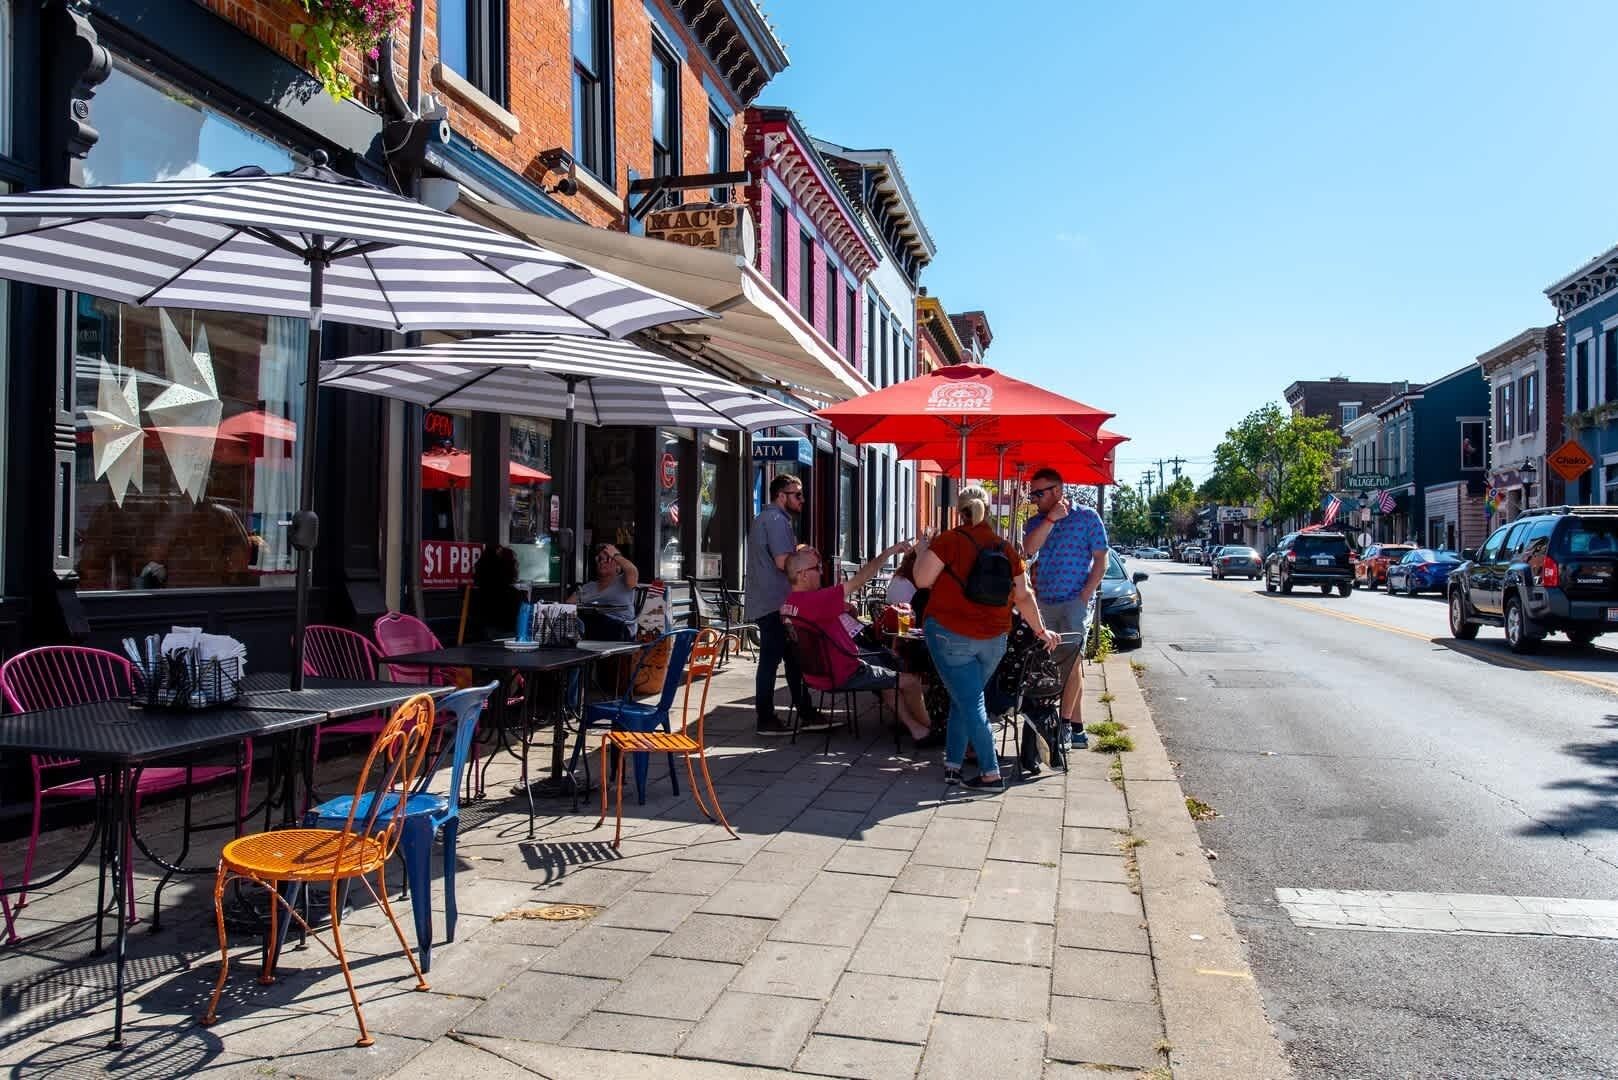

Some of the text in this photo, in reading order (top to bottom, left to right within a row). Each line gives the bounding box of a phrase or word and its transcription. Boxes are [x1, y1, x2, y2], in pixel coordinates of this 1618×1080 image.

[649, 208, 735, 230] MAC'S
[425, 412, 452, 437] OPEN
[754, 445, 784, 457] ATM
[1348, 477, 1376, 488] VILLAGE
[424, 543, 443, 577] $1
